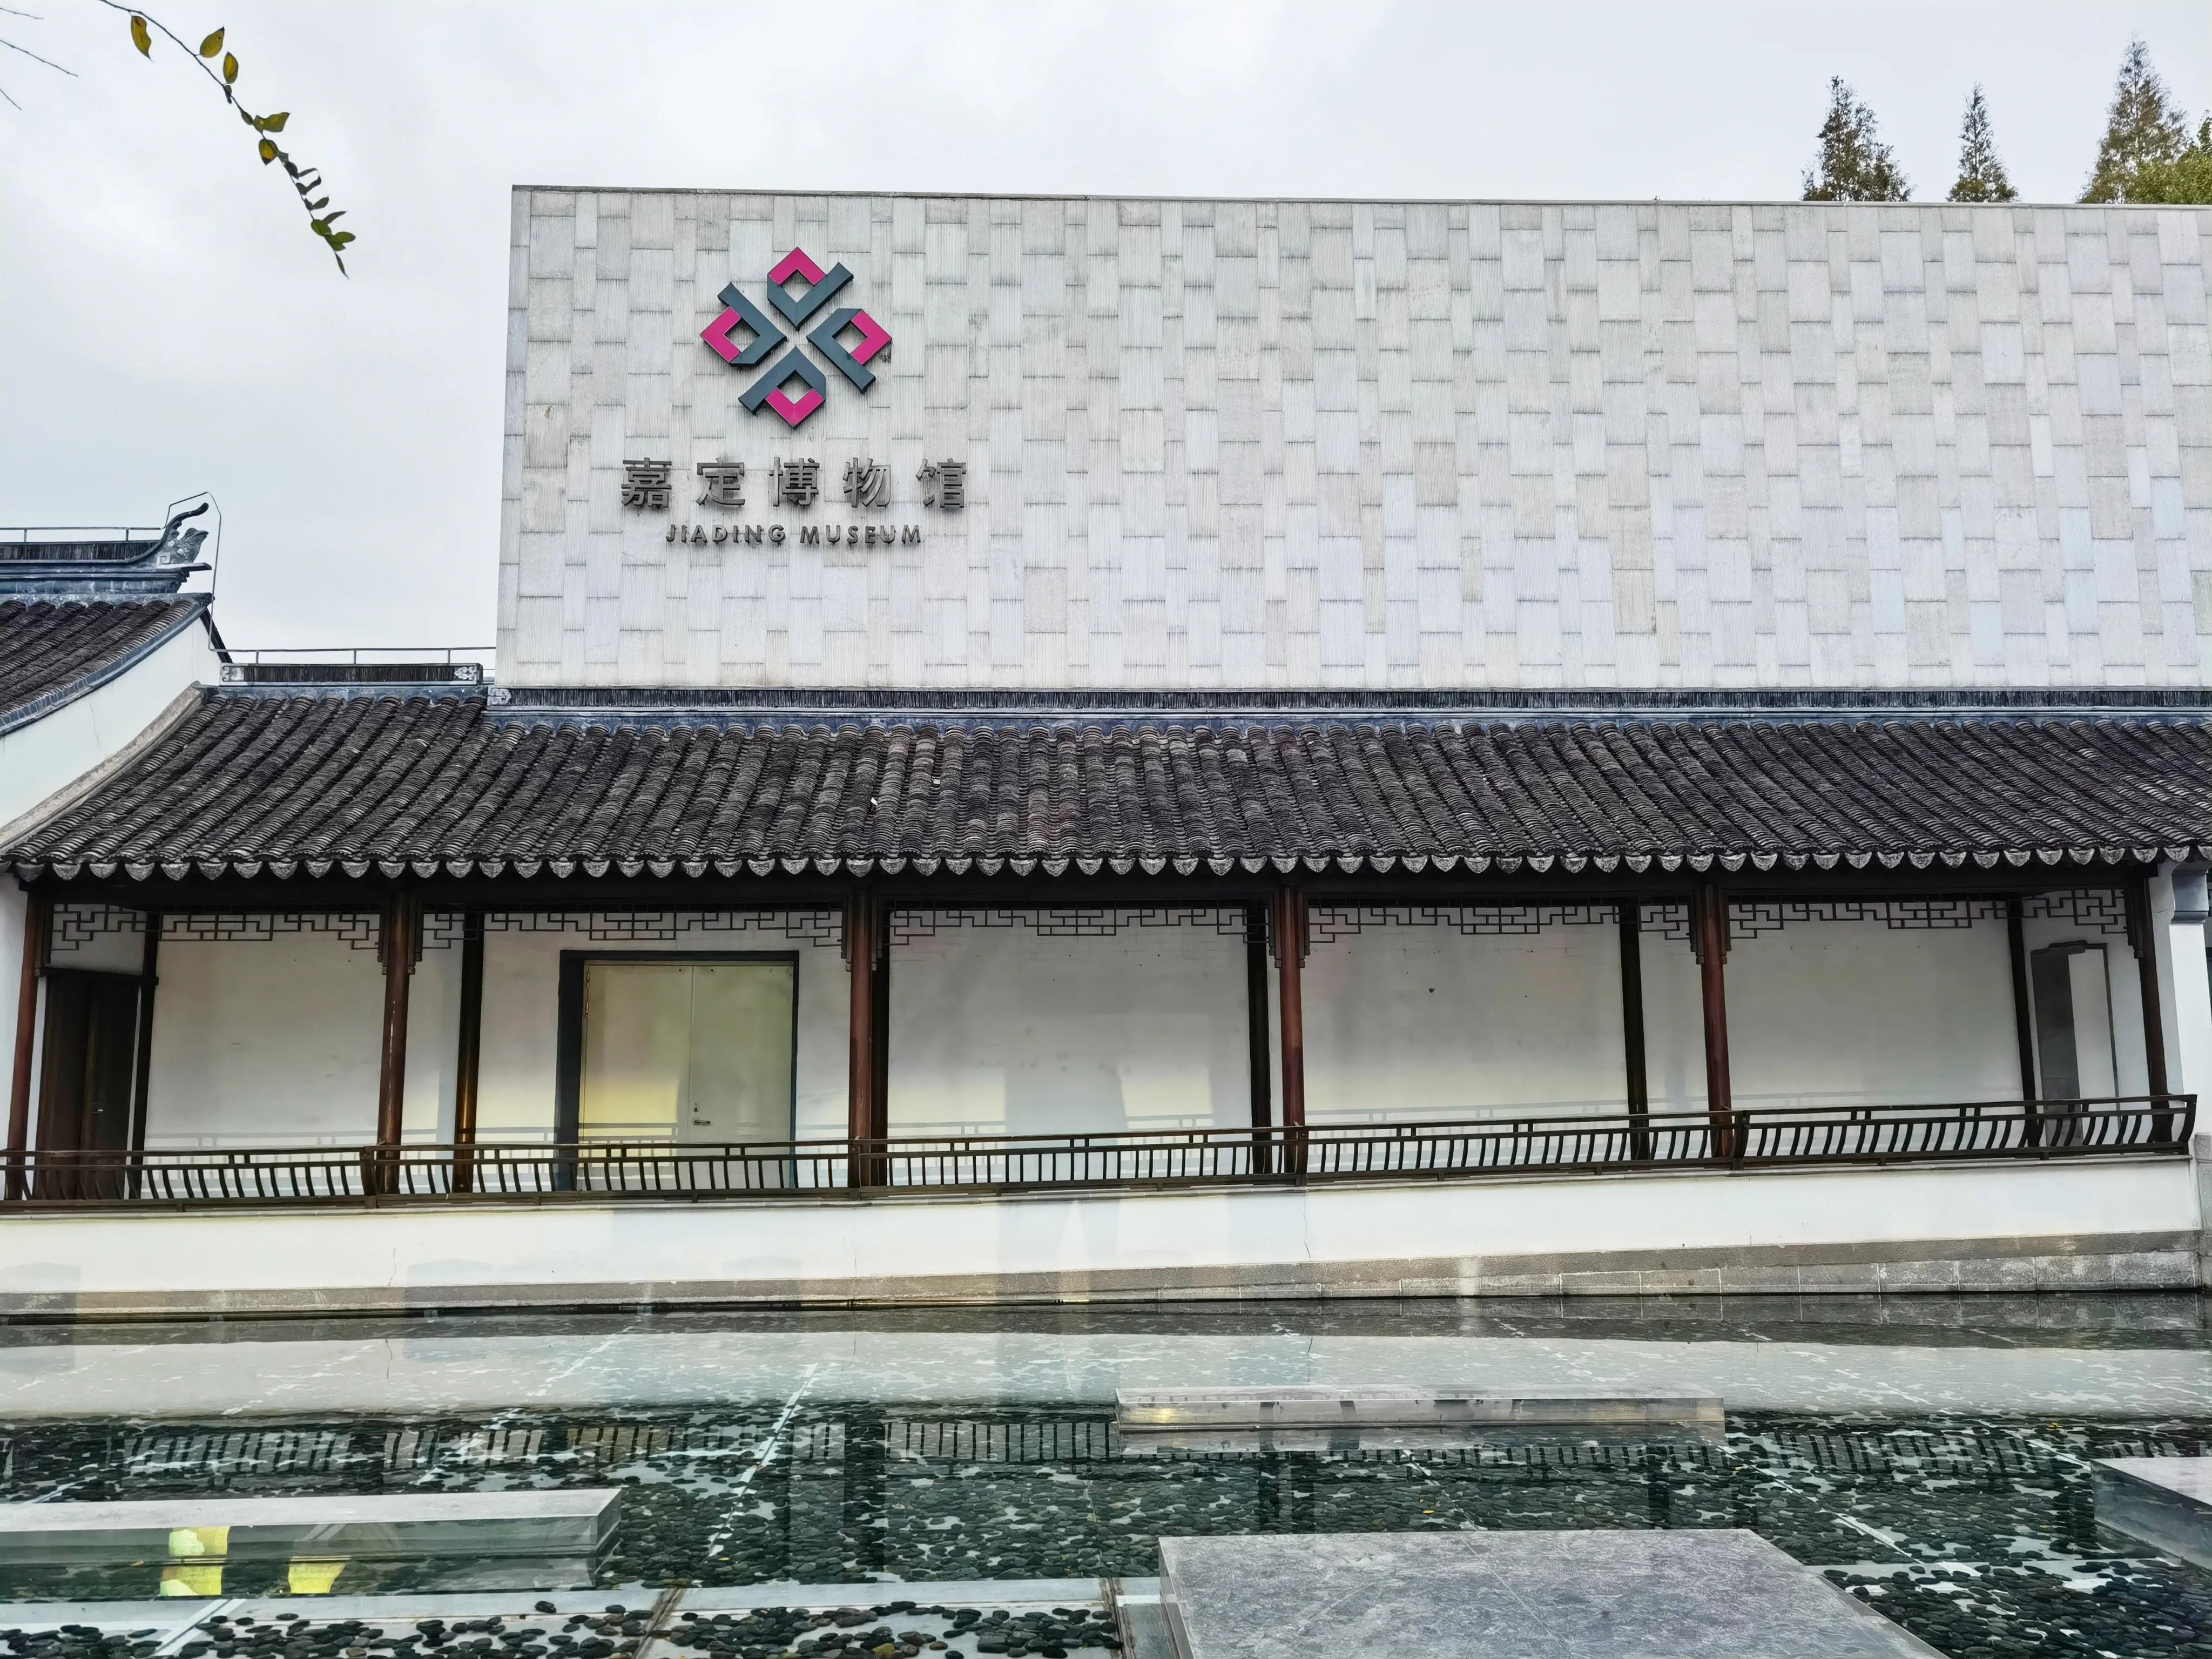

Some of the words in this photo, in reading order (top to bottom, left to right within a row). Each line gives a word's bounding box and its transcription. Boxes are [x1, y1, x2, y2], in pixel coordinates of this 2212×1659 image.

[621, 457, 967, 509] 嘉定博物馆
[665, 524, 786, 544] JIADING
[800, 524, 922, 544] MUSEUM
